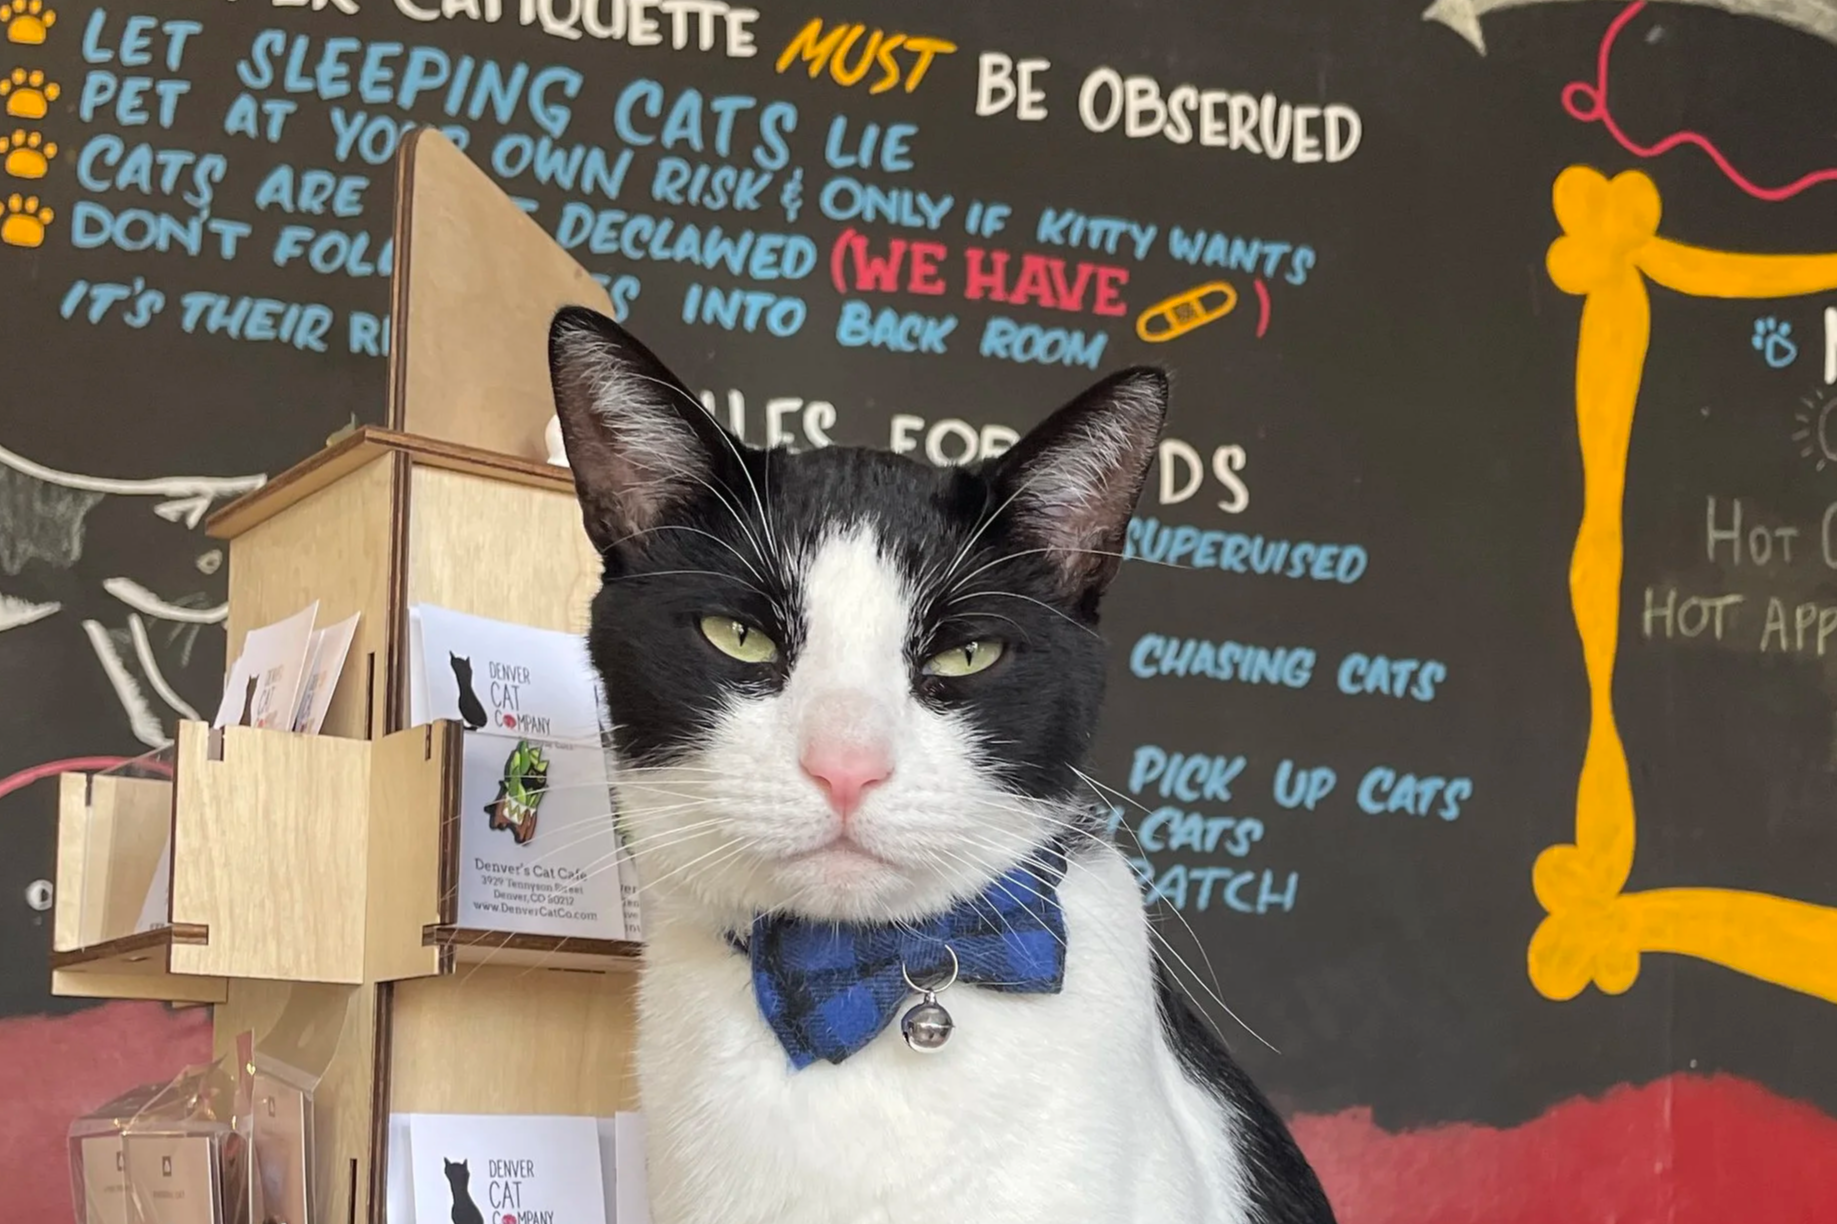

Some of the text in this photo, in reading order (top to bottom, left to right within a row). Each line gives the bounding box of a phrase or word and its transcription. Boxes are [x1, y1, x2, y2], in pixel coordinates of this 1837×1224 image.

[82, 7, 918, 172] LET SLEEPING CATS LIE
[775, 17, 957, 95] MUST
[975, 51, 1050, 121] BE
[1078, 66, 1362, 163] OBSERVED
[79, 70, 191, 128] PET
[224, 92, 298, 143] AT
[491, 133, 634, 200] OWN
[652, 156, 774, 211] RISK
[780, 167, 804, 223] &
[819, 176, 955, 230] ONLY
[964, 200, 1012, 238] IF
[1036, 207, 1158, 261] KITTY
[1168, 225, 1316, 286] WANTS
[76, 134, 227, 207] CATS
[255, 164, 369, 217] ARE
[556, 201, 818, 280] DECLAWED
[831, 228, 948, 295] (WE
[964, 247, 1129, 317] HAVE
[60, 276, 165, 328] IT'S
[180, 291, 334, 352] THEIR
[71, 201, 252, 260] DON'T
[682, 284, 806, 337] INTO
[836, 300, 957, 355] BACK
[979, 317, 1108, 369] ROOM
[1123, 516, 1367, 584] SUPERVISED
[1643, 587, 1744, 640] HOT
[489, 661, 530, 684] DENVER
[490, 680, 519, 711] CAT
[1130, 633, 1447, 701] CHASING CATS
[1128, 745, 1472, 821] PICK UP CATS
[1138, 806, 1264, 857] CATS
[474, 858, 530, 876] Denver's
[533, 864, 555, 879] Cat
[507, 878, 551, 892] Tennyson
[472, 901, 597, 921] www.DenverCatCo.com
[489, 1159, 534, 1178] DENVER
[489, 1180, 522, 1209] CAT
